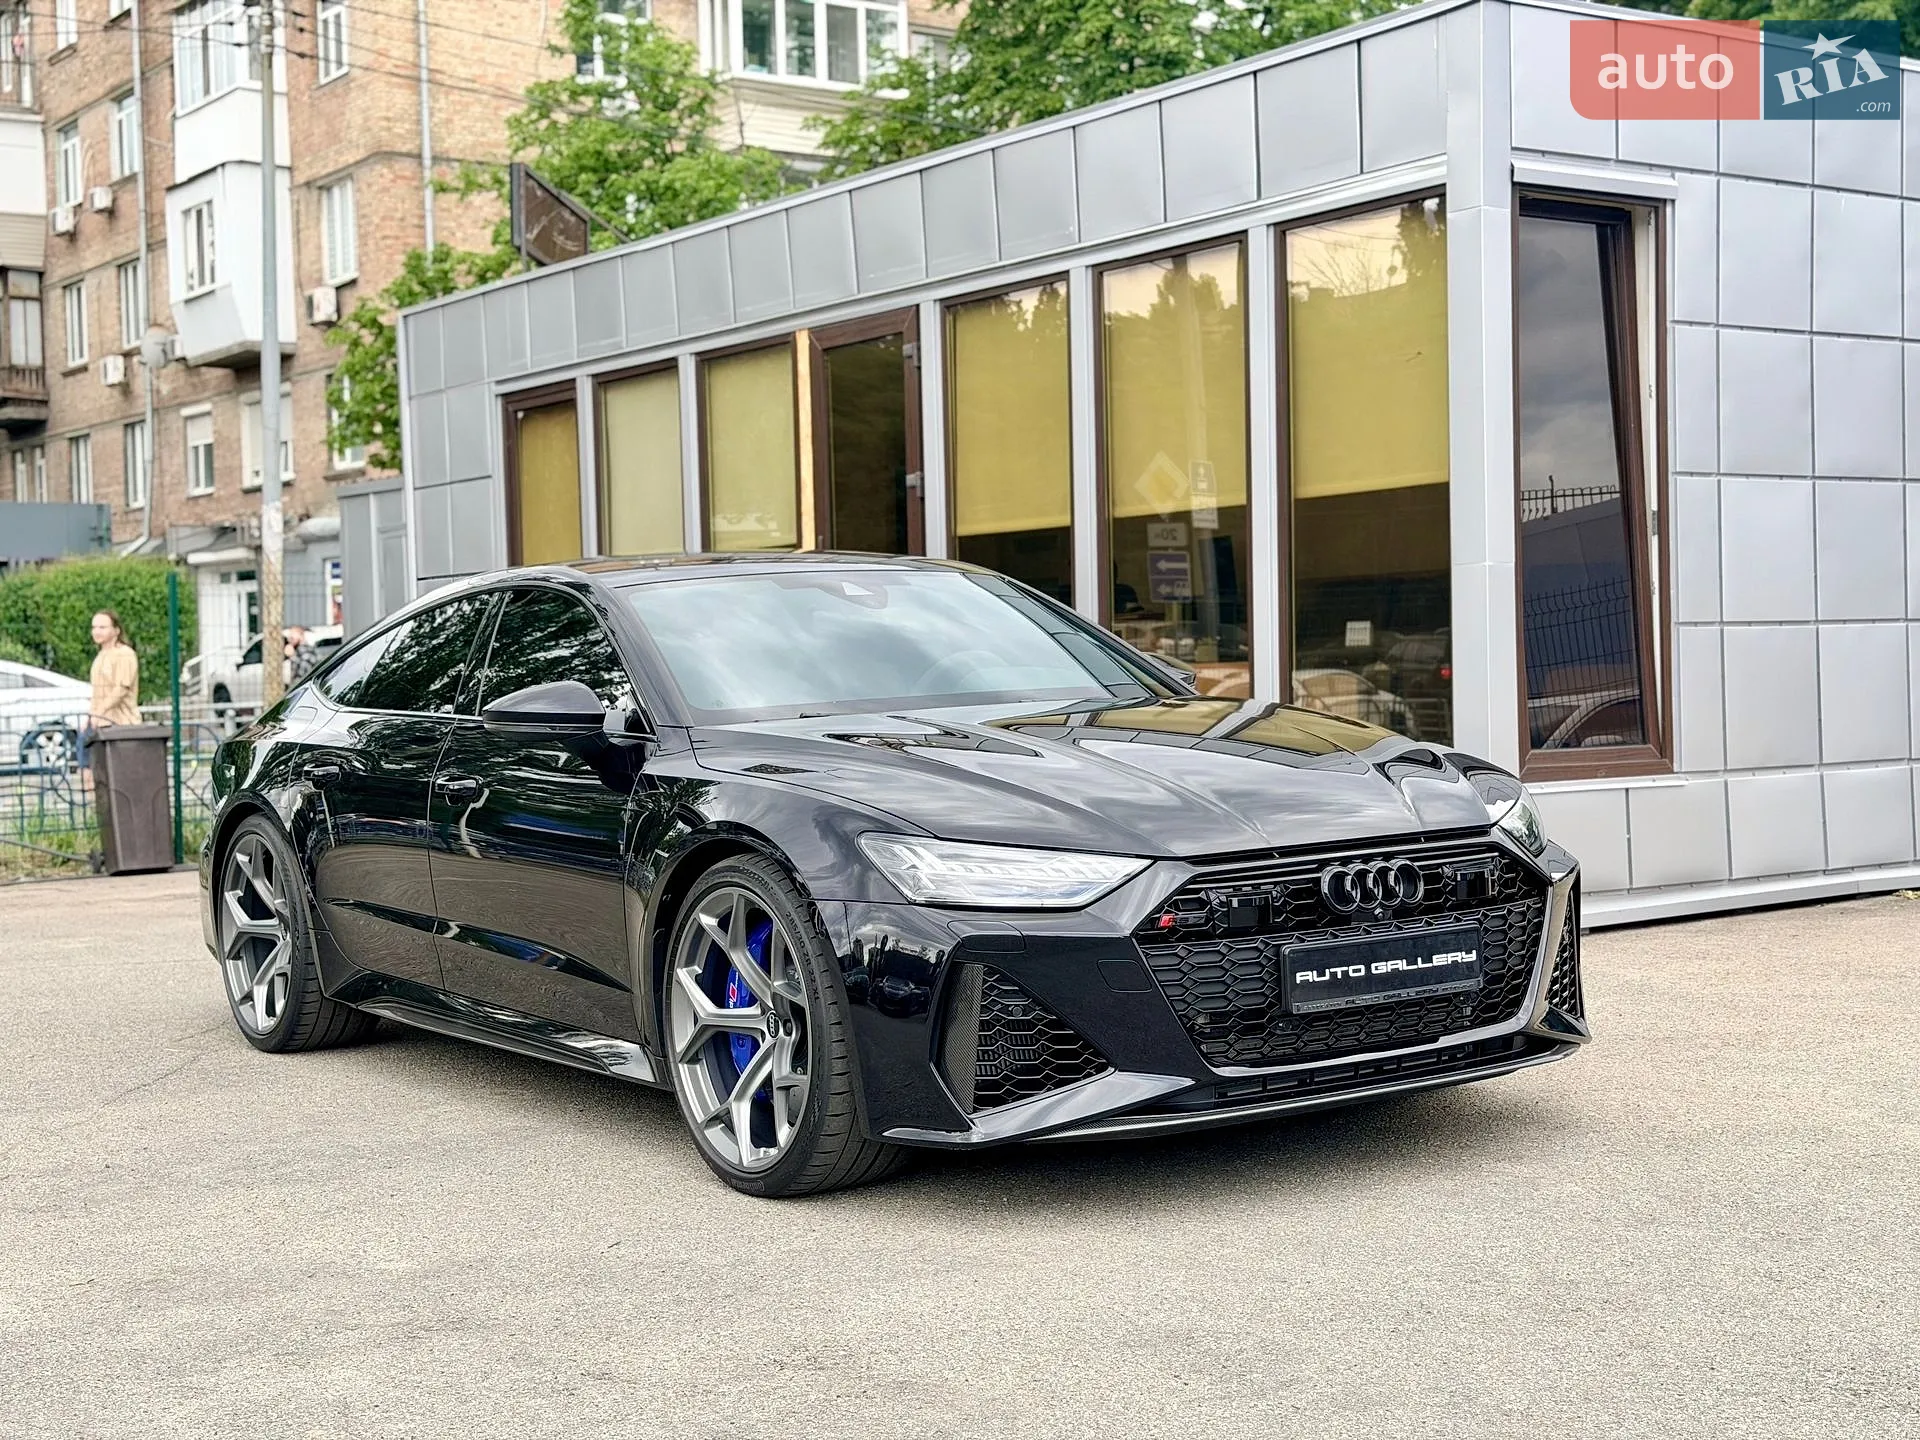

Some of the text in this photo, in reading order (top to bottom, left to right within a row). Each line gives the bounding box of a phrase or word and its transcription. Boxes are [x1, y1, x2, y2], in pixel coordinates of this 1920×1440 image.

[1296, 950, 1477, 984] AUTO GALLERY
[1383, 987, 1439, 1000] GALLERY
